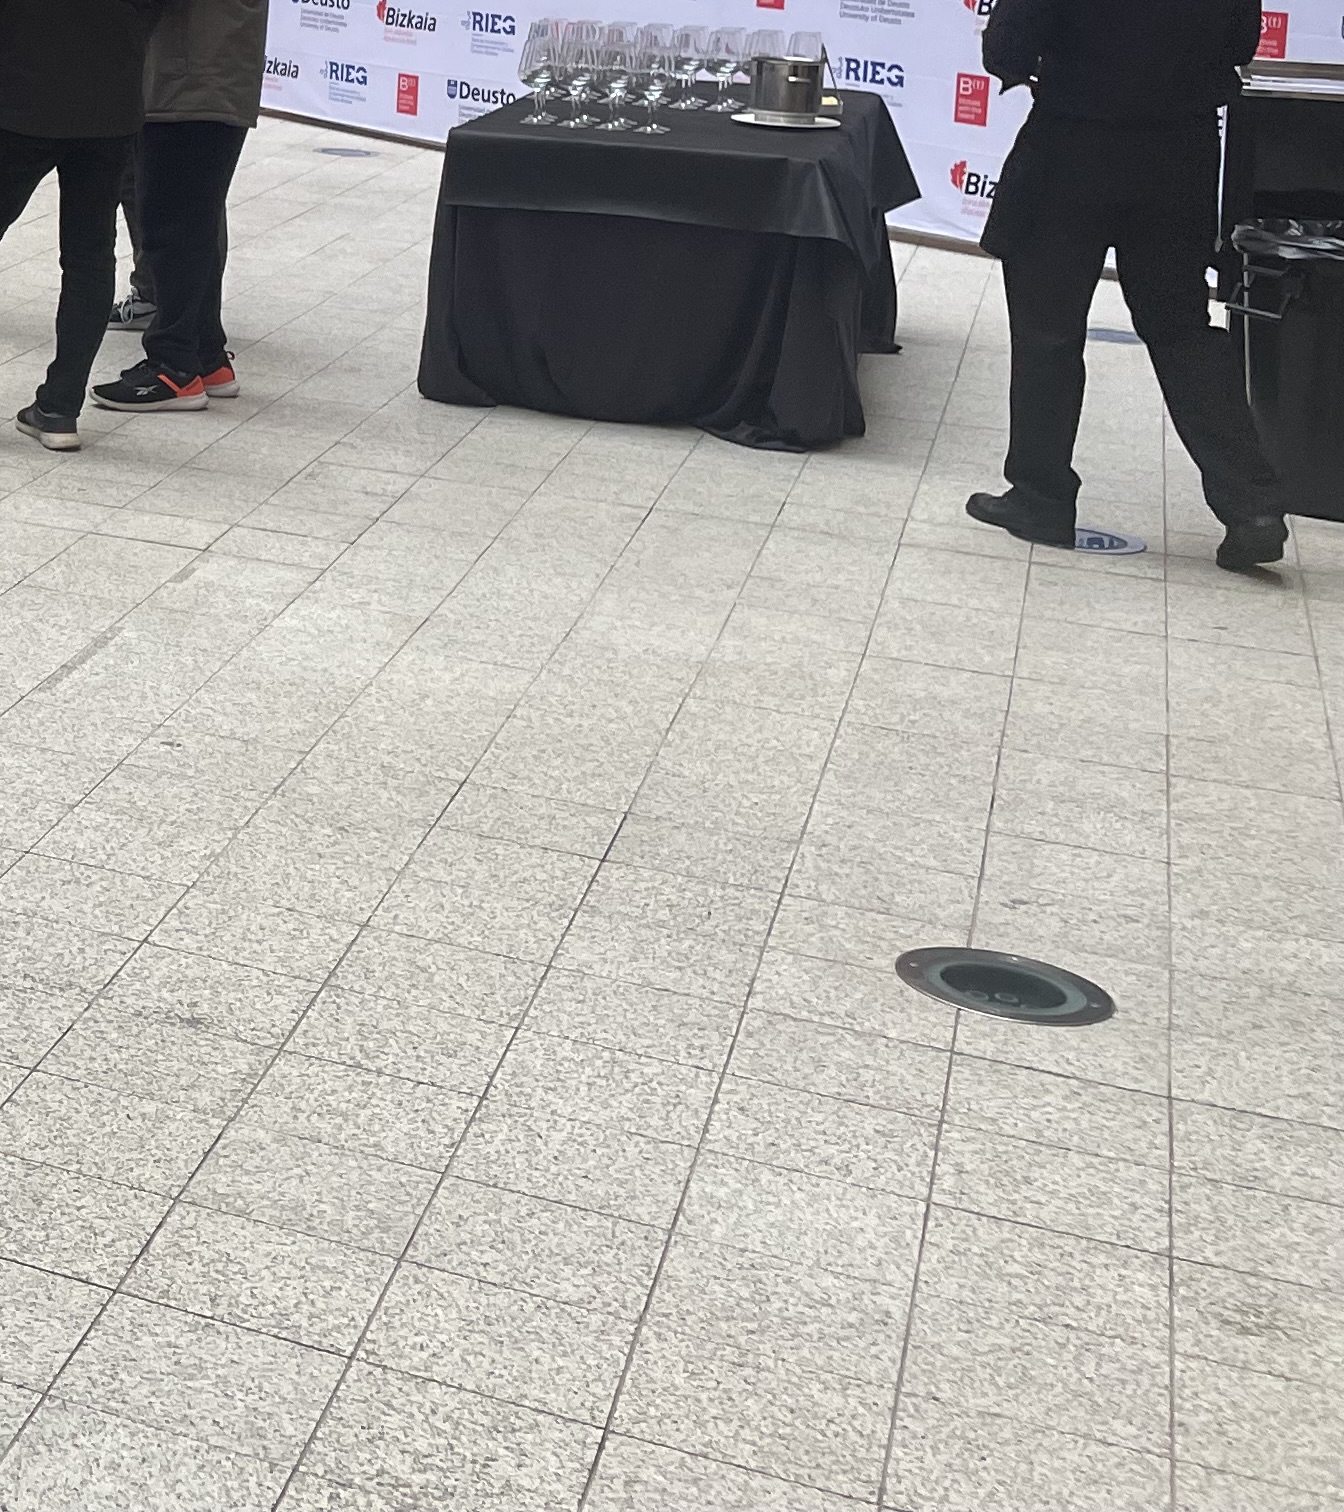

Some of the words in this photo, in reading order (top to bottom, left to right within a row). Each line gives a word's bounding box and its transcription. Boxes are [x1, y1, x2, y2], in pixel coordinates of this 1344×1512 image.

[385, 7, 437, 32] Bizkaia
[471, 11, 516, 35] RIEG
[263, 55, 299, 79] izkaia
[329, 61, 368, 86] RIEG
[845, 57, 904, 88] RIEG
[459, 81, 516, 104] Deusto
